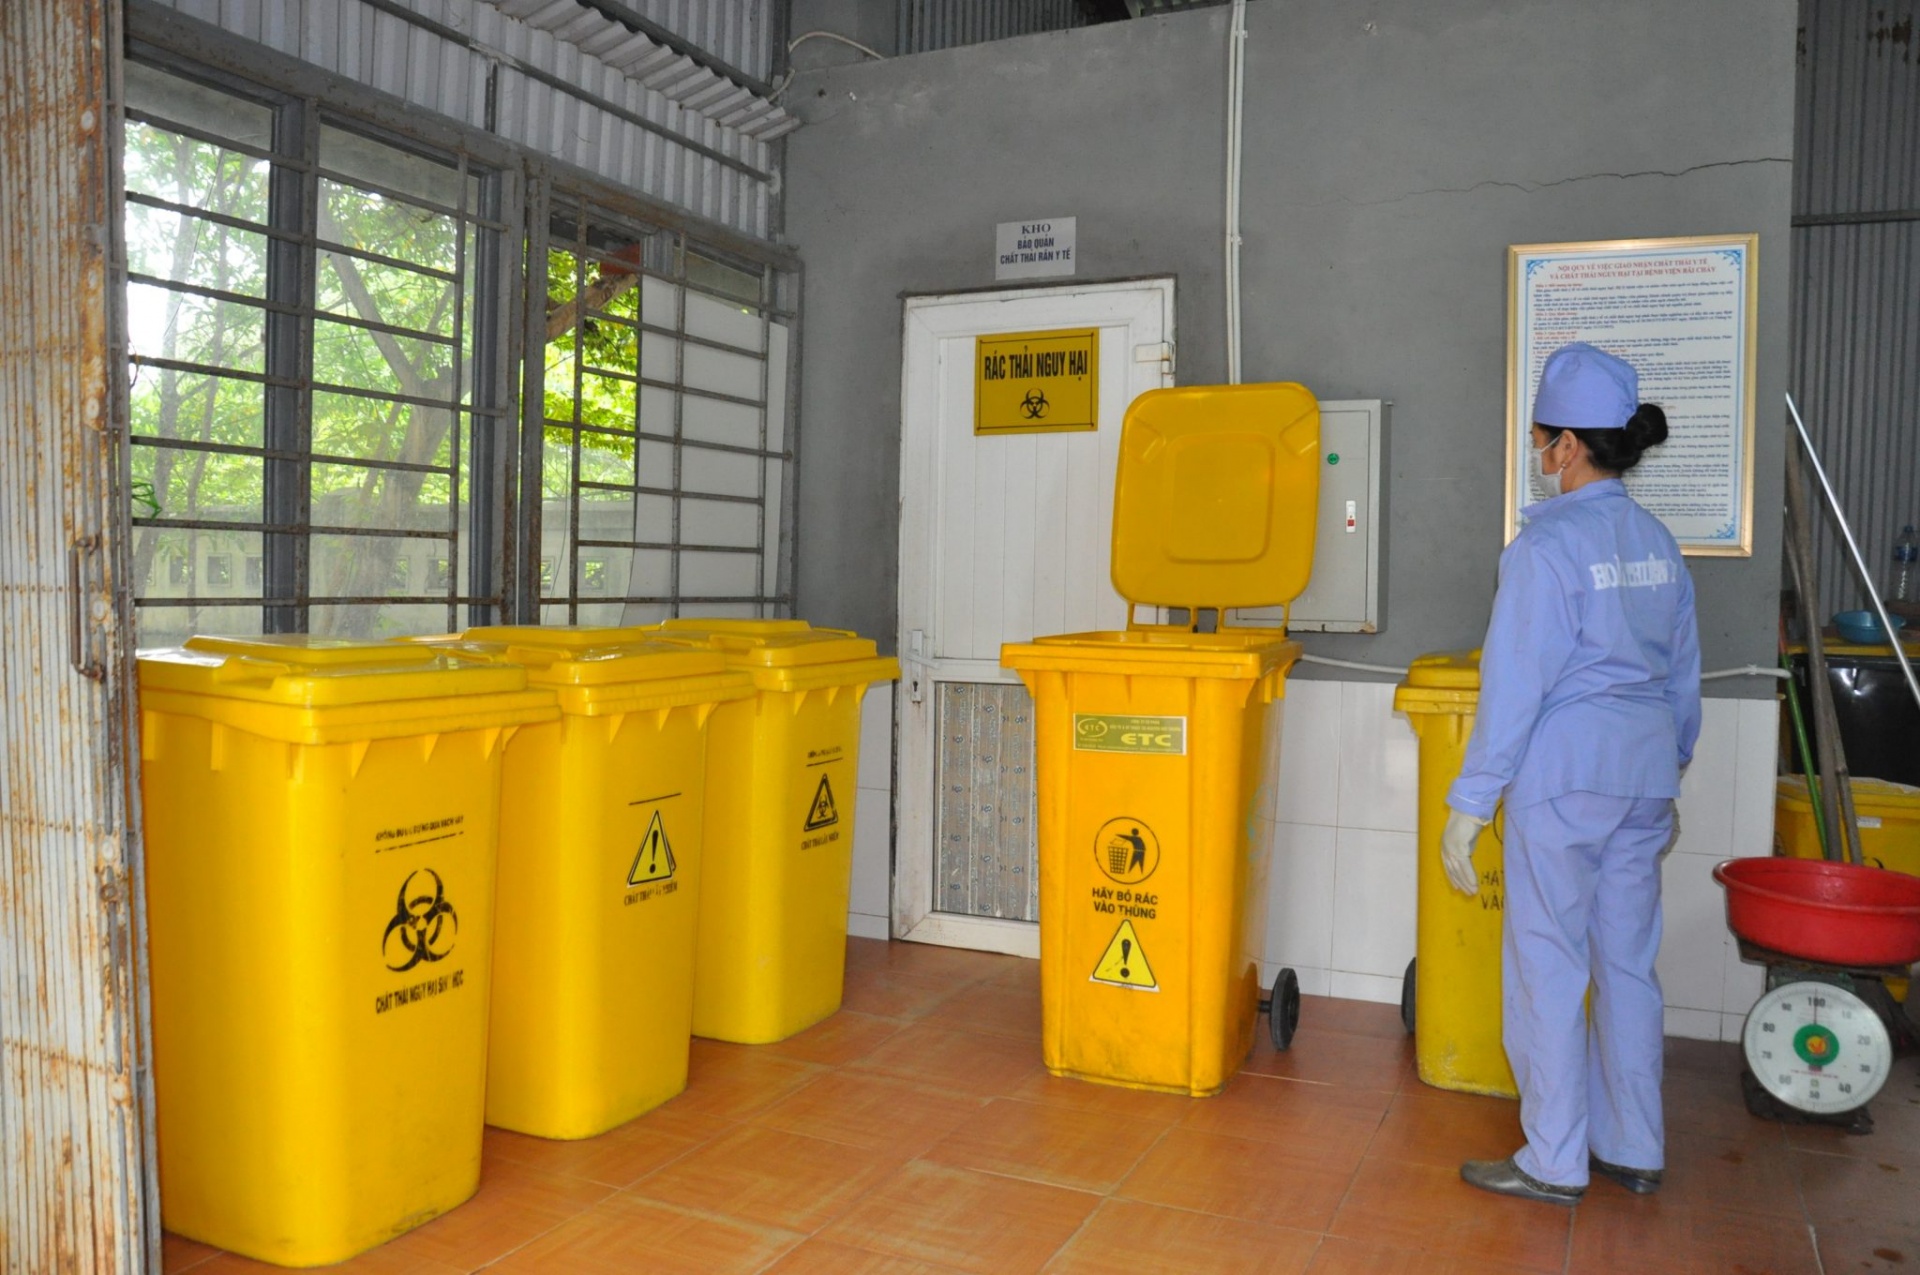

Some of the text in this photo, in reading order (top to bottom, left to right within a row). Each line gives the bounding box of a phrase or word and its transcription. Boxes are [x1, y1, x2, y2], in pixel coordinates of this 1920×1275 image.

[1021, 223, 1051, 235] KHO
[1055, 250, 1061, 261] Y
[984, 345, 1088, 382] RÁC THẢI NGUY HẠI
[1120, 732, 1172, 747] ETC
[1092, 886, 1114, 900] HÃY
[1134, 891, 1159, 906] RÁC
[1093, 900, 1157, 919] VÀO THÙNG
[1808, 996, 1826, 1008] 100
[1763, 1022, 1775, 1033] 80
[1857, 1035, 1871, 1046] 20
[1779, 1074, 1792, 1085] 60
[1838, 1082, 1851, 1094] 40
